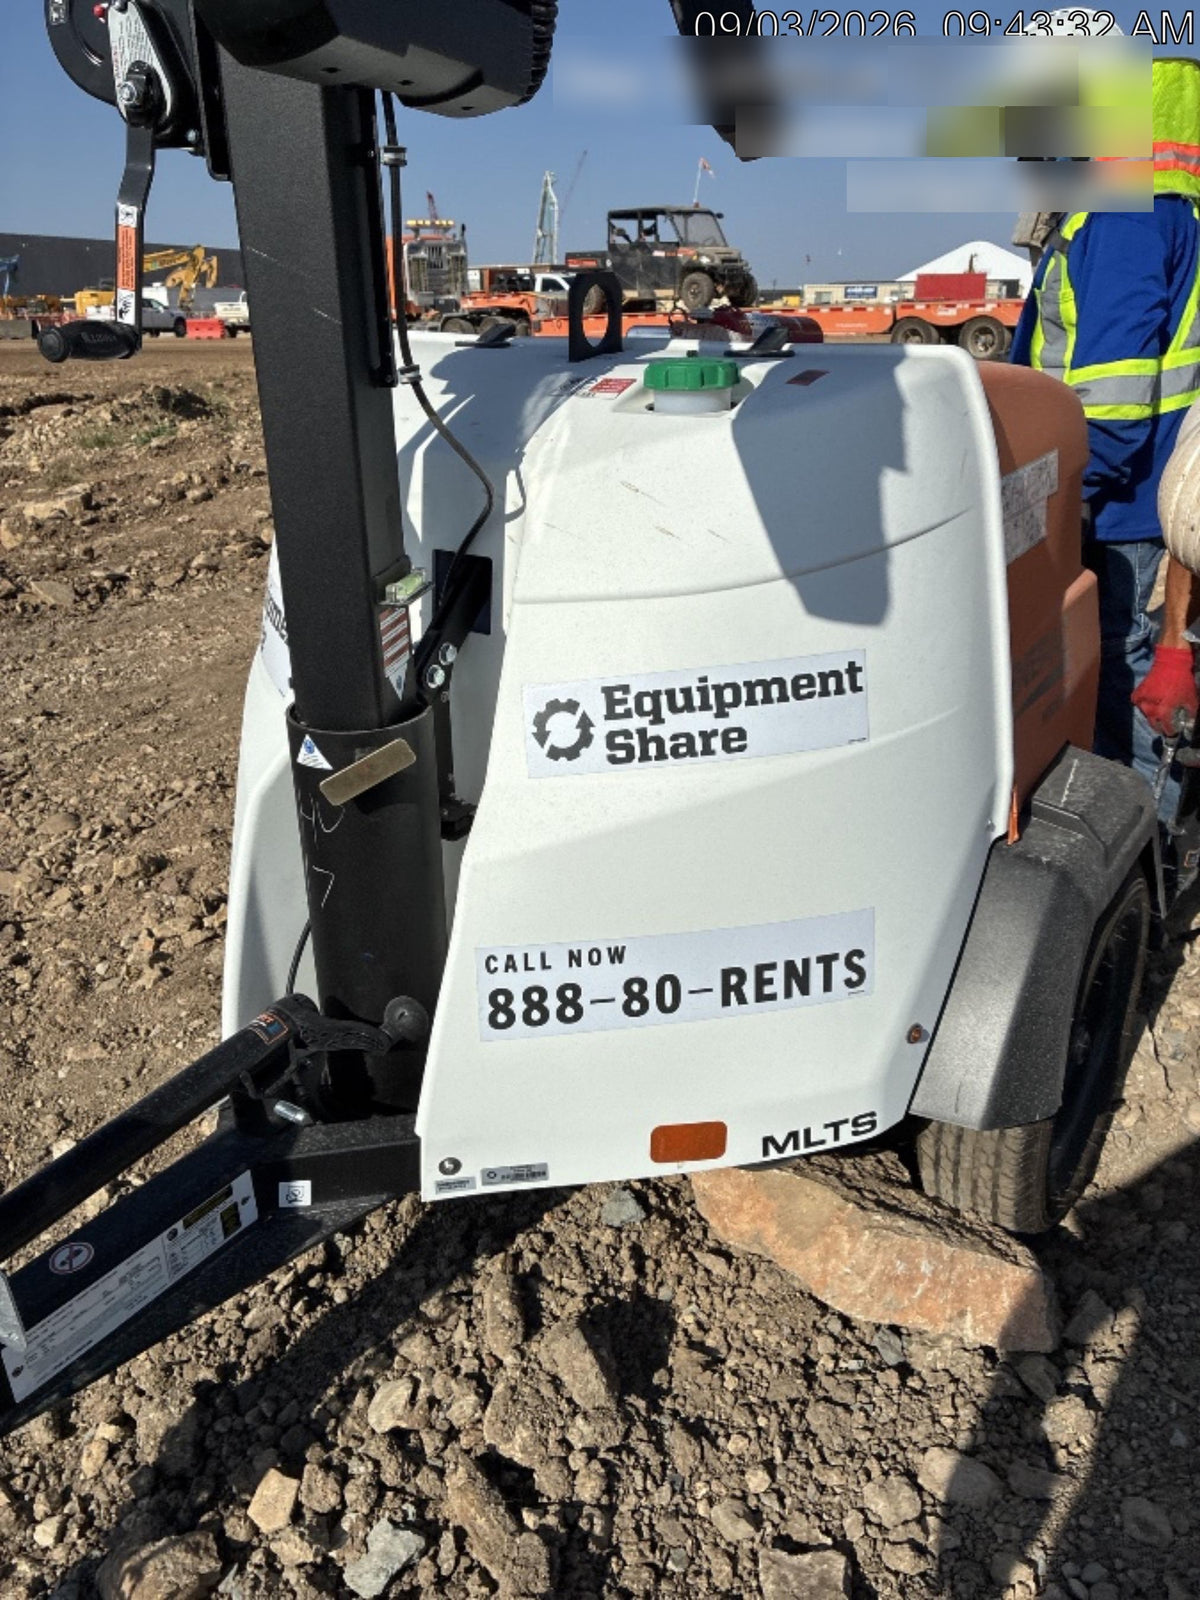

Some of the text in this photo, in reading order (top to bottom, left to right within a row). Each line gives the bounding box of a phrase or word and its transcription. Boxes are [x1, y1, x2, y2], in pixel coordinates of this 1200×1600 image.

[601, 660, 864, 726] Equipment
[604, 726, 748, 765] Share
[484, 945, 627, 975] CALL NOW
[487, 948, 868, 1031] 888-80-RENTS
[762, 1110, 878, 1158] MLTS
